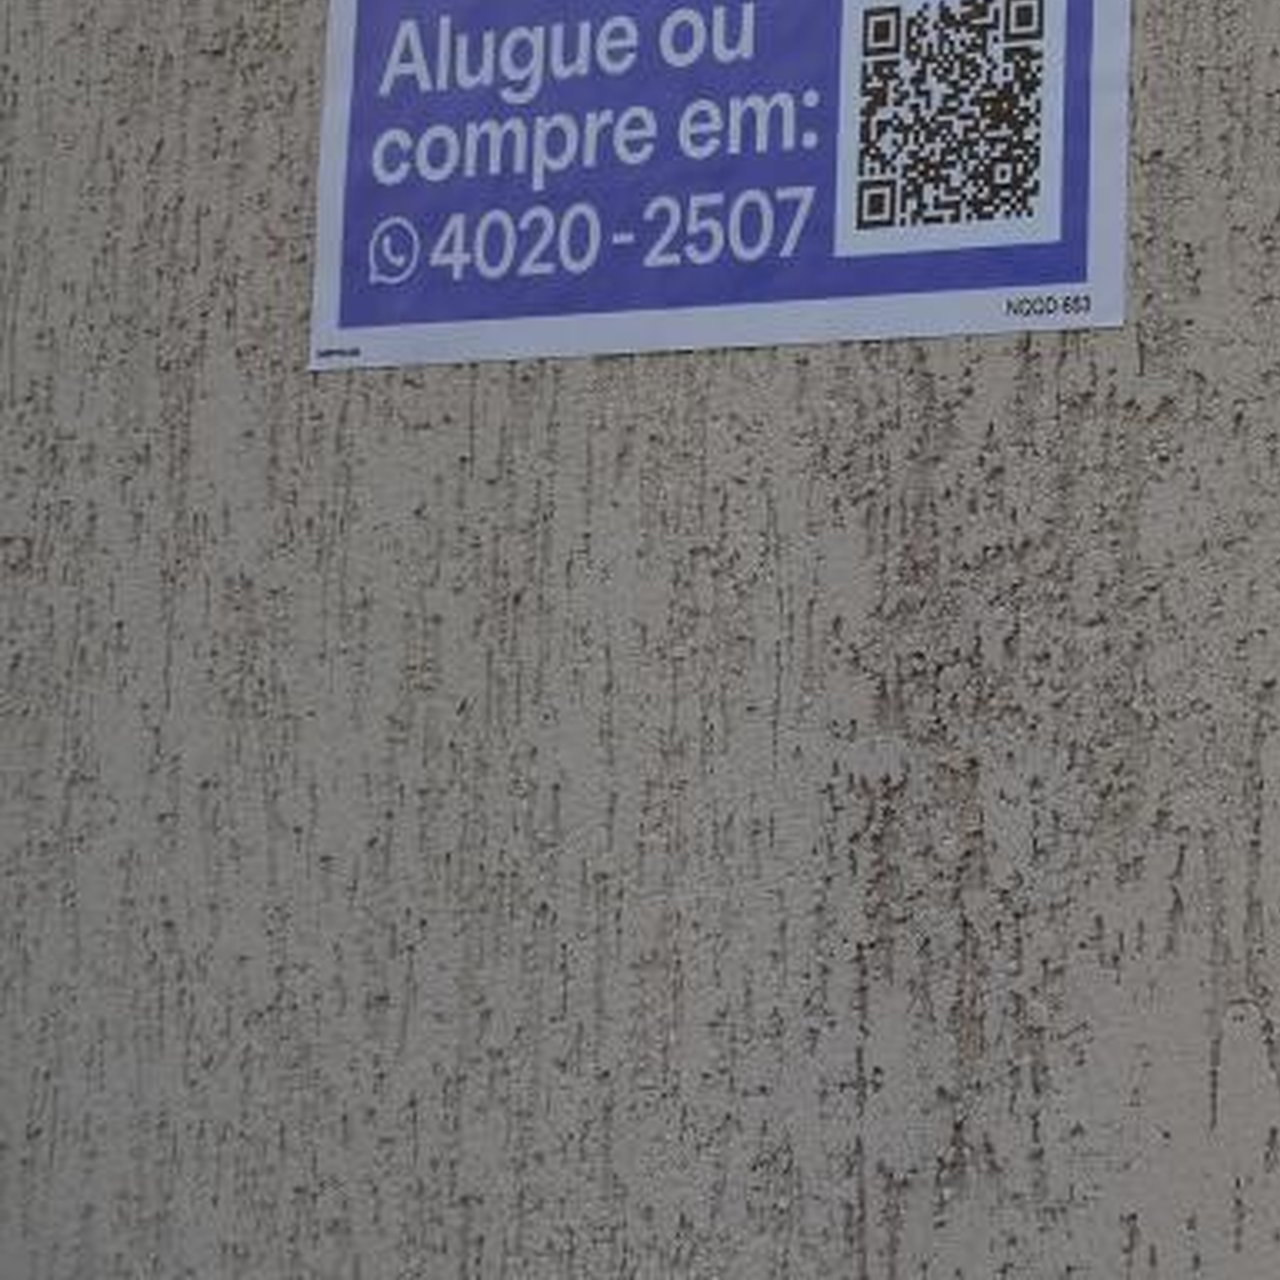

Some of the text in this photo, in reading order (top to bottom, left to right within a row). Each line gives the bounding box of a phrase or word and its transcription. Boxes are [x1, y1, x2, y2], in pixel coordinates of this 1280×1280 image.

[378, 0, 756, 105] Alugue ou
[370, 89, 820, 192] compre em:
